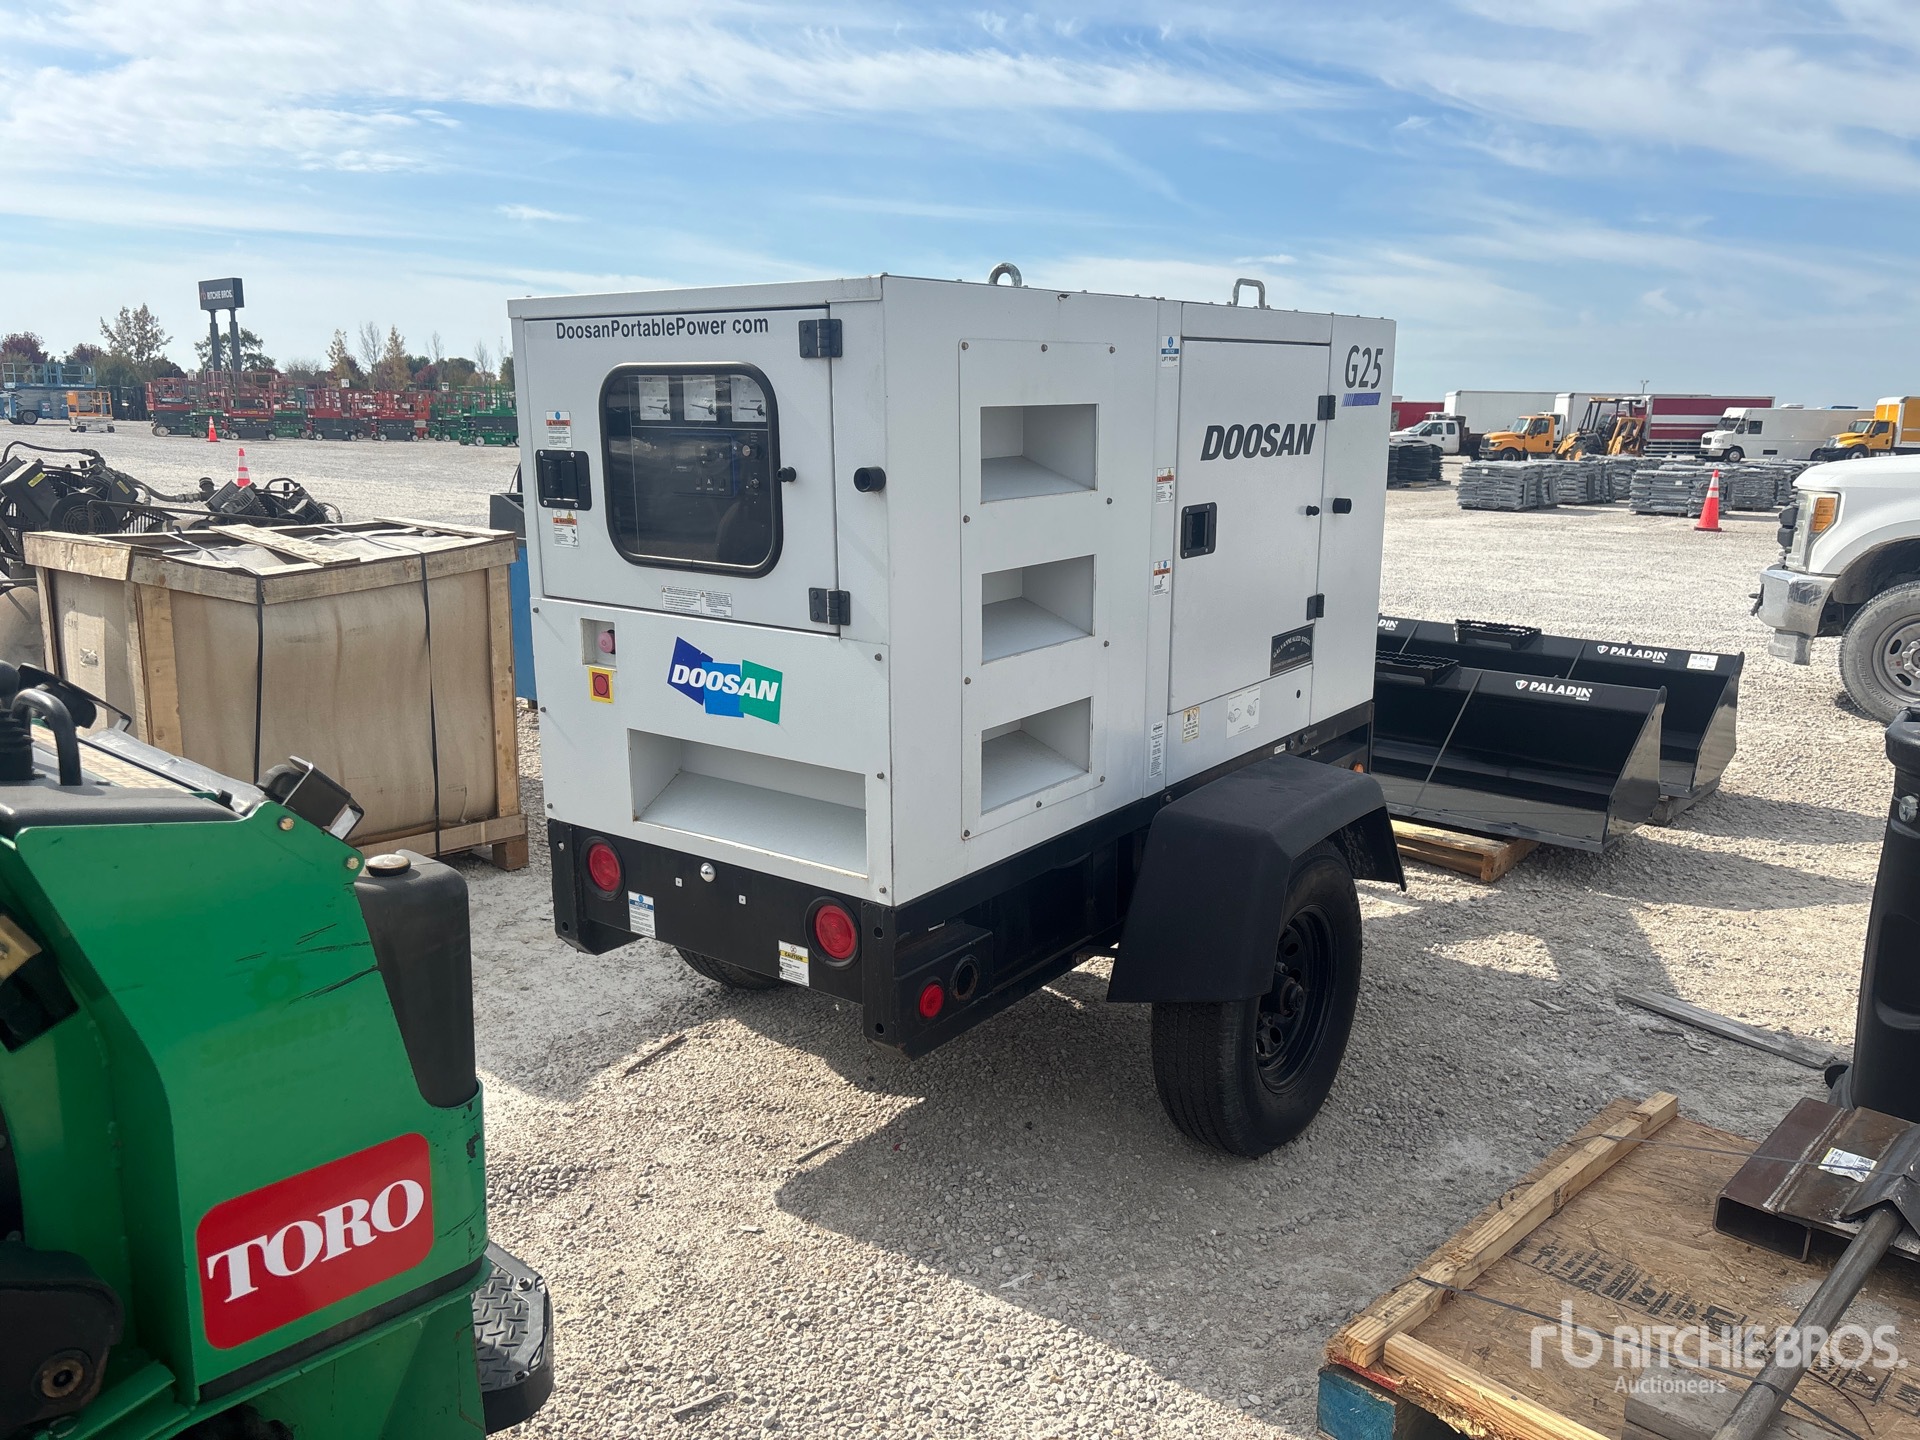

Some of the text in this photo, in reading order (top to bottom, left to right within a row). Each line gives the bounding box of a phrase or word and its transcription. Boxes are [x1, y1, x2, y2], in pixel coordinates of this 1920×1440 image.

[1345, 345, 1384, 389] G25
[1200, 423, 1317, 461] DOOSAN
[1610, 646, 1669, 661] PALADIN
[671, 664, 779, 702] DOOSAN
[1529, 681, 1593, 698] PALADIN
[784, 951, 803, 961] CAUTION
[206, 1179, 425, 1303] TORO
